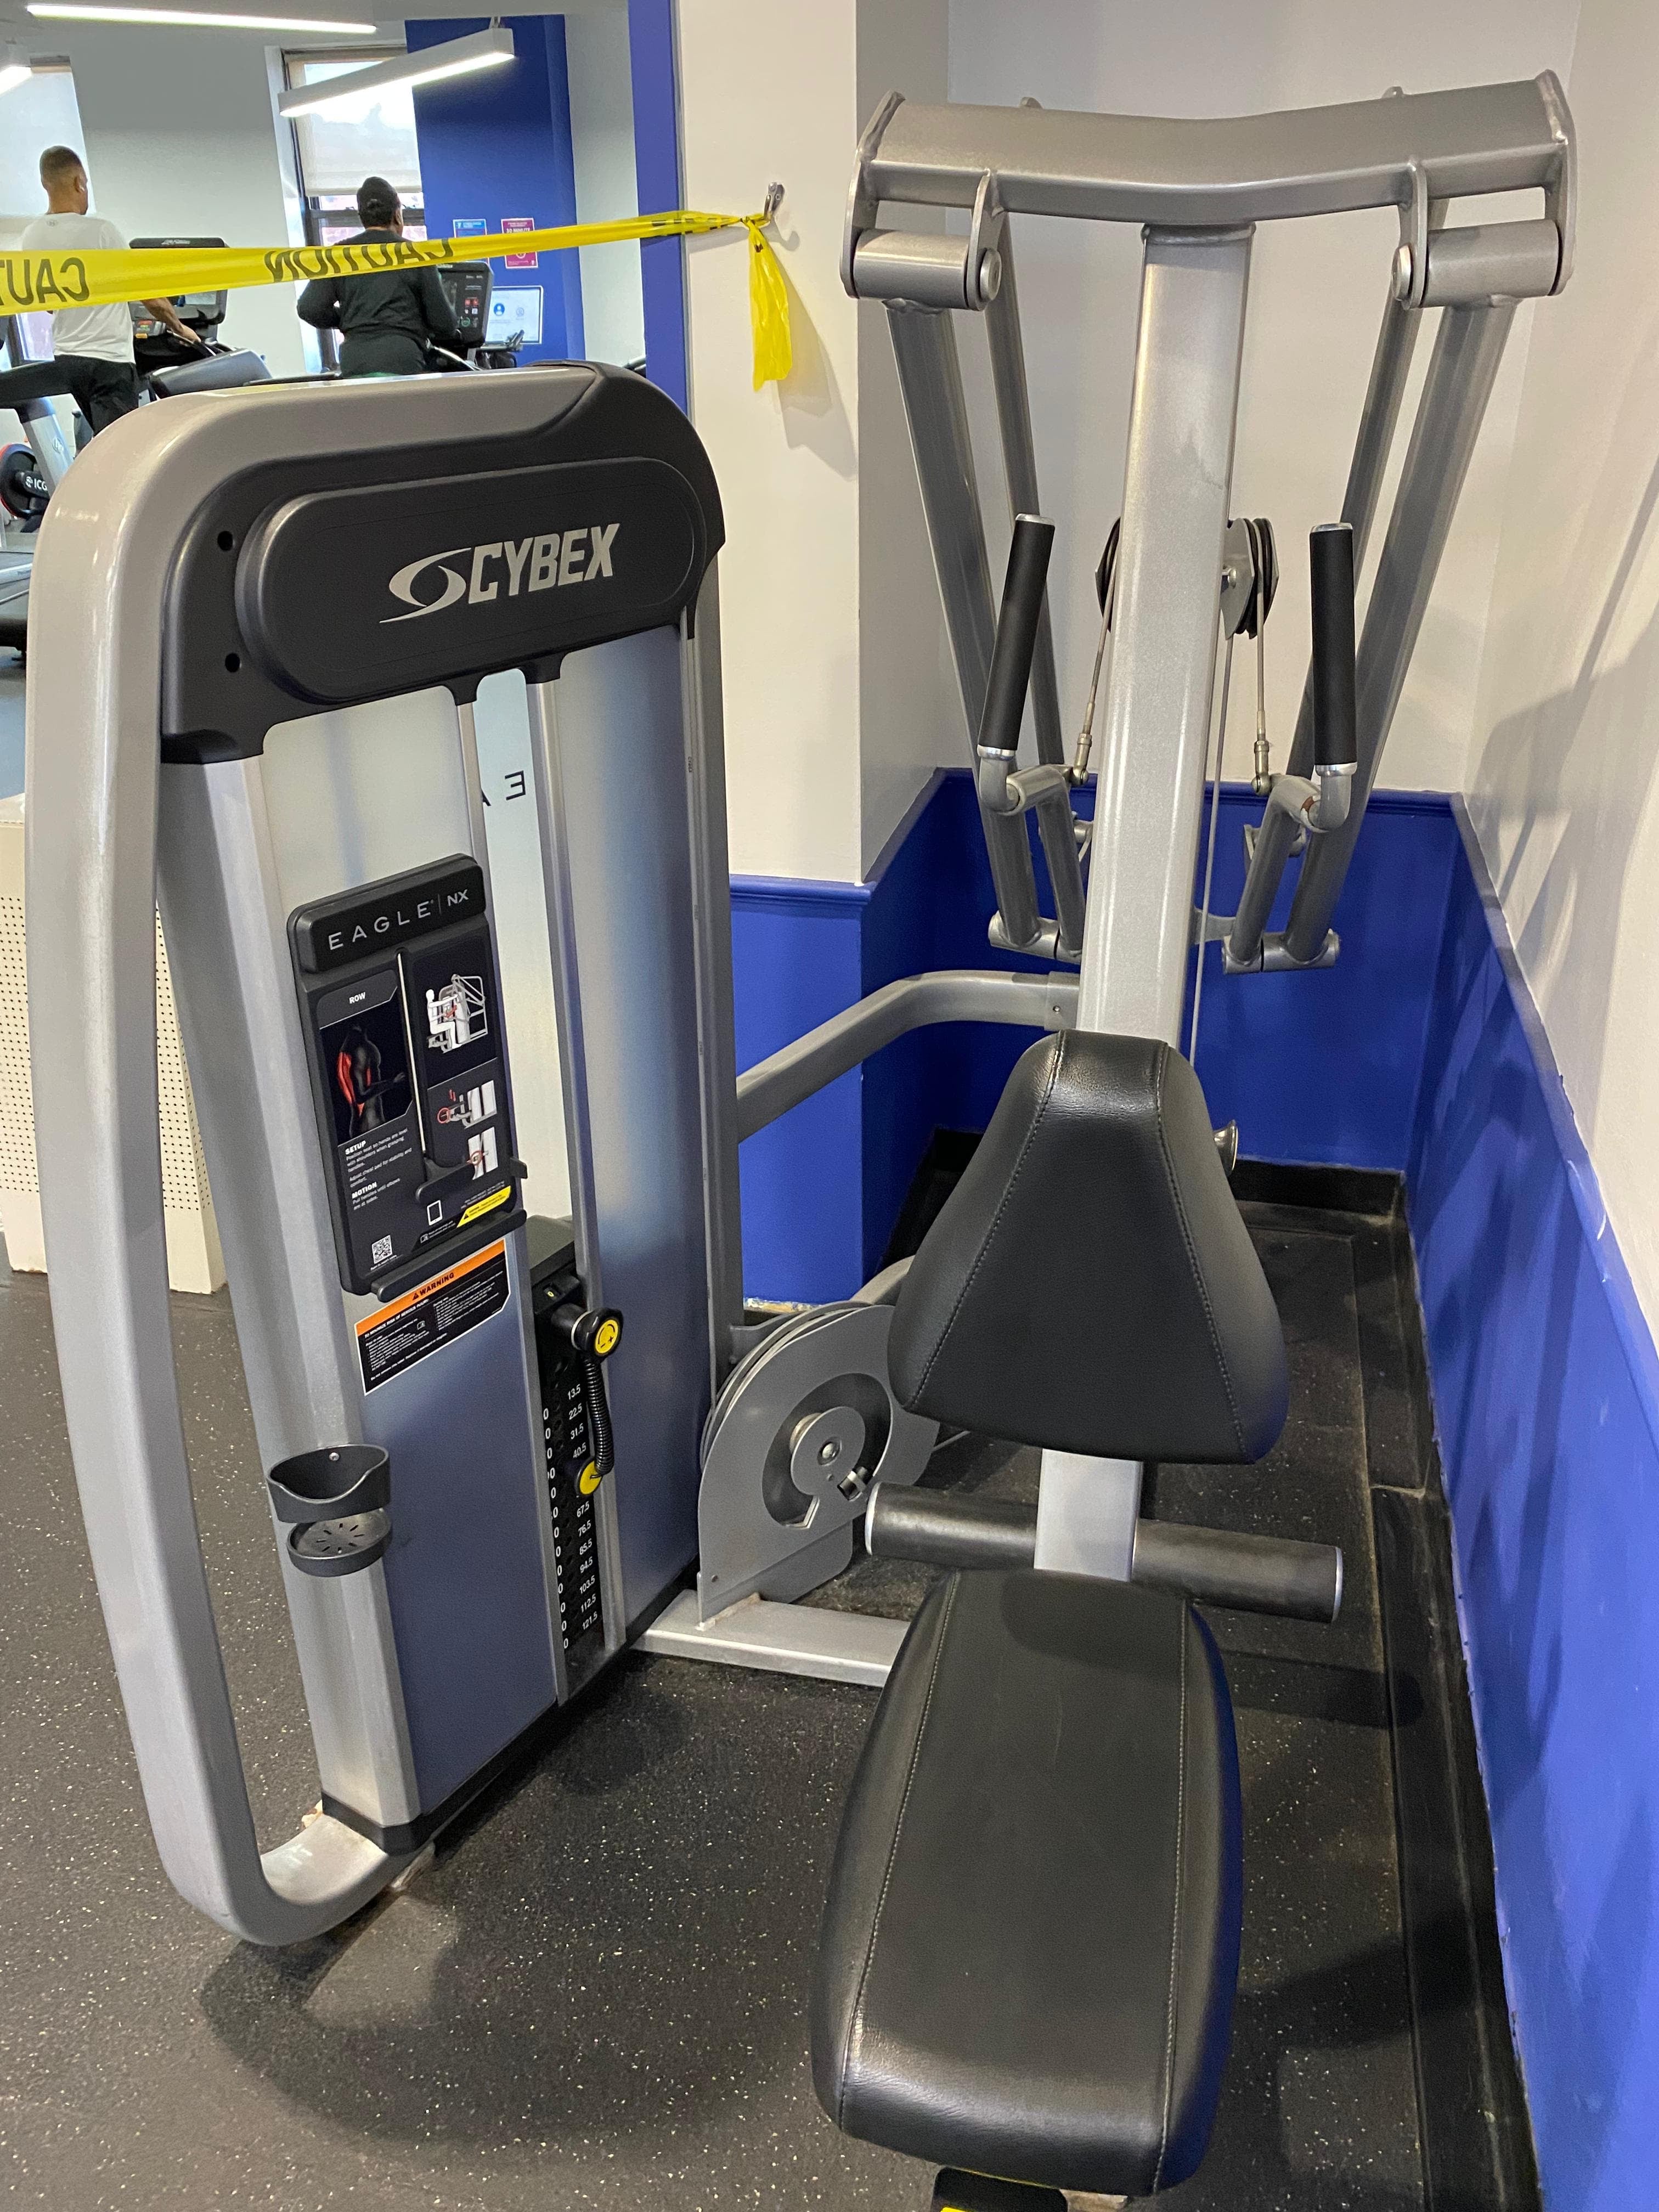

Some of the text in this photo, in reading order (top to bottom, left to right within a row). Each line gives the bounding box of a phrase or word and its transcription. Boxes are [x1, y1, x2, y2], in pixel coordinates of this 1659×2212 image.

[468, 523, 620, 604] CYBEX
[328, 889, 469, 950] EAGLE NX
[349, 992, 366, 1004] ROW
[345, 1140, 366, 1155] SETUP
[352, 1182, 377, 1199] MOTION
[420, 1272, 454, 1295] WARNING
[568, 1384, 581, 1400] 13.5
[568, 1403, 582, 1420] 22.5
[571, 1423, 584, 1440] 31.5
[573, 1442, 586, 1458] 40.5
[578, 1520, 591, 1537] 76.5
[579, 1538, 592, 1555] 85.5
[580, 1556, 593, 1573] 94.5
[579, 1575, 595, 1594] 103.5
[581, 1593, 596, 1613] 112.5
[582, 1611, 597, 1630] 121.5
